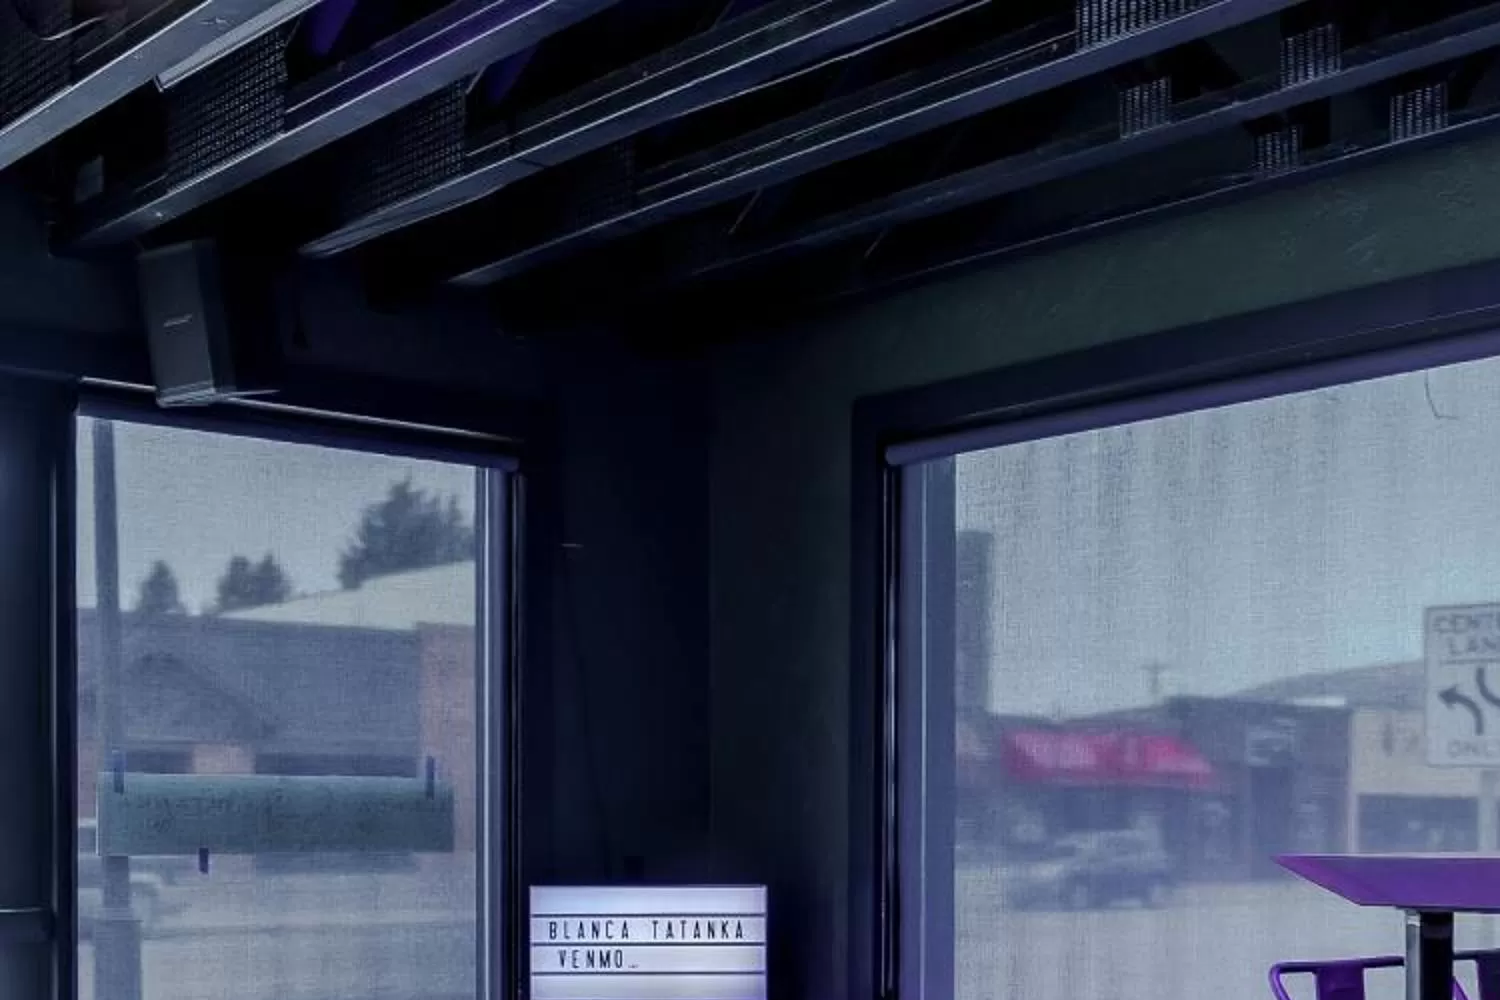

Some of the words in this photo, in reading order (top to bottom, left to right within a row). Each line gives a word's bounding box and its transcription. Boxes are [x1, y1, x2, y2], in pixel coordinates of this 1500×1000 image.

[549, 920, 629, 940] BLANCA
[652, 920, 744, 940] TATANKA
[558, 949, 623, 969] VENMO
